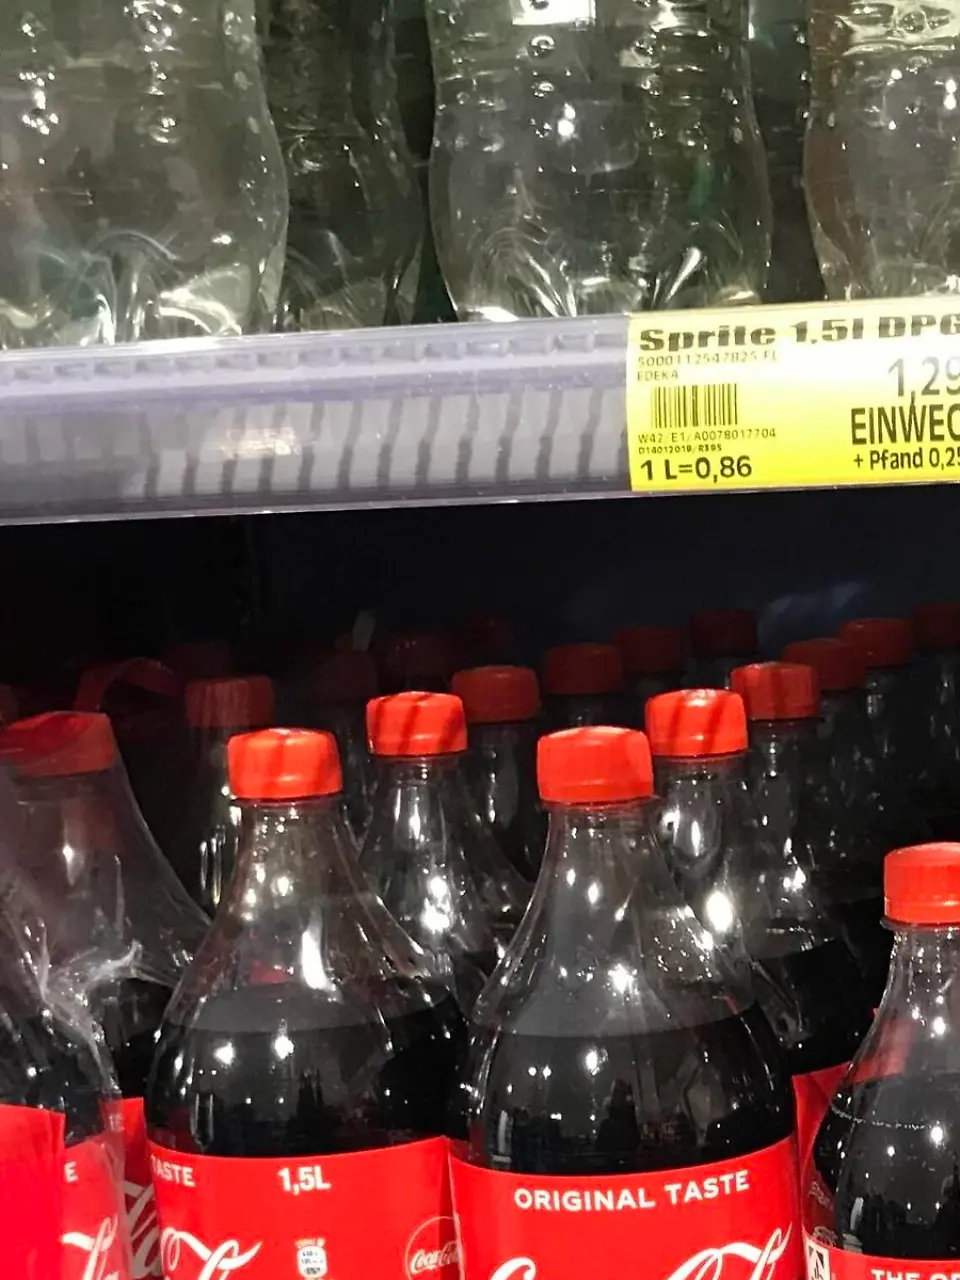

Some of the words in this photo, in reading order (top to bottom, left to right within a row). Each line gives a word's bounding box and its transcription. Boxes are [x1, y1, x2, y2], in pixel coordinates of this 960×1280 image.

[640, 325, 776, 352] Sprite
[640, 460, 653, 481] 1
[665, 455, 753, 483] L=0,86
[853, 455, 864, 467] +
[870, 448, 924, 471] Pfand
[278, 1165, 331, 1195] 1,5L
[514, 1187, 655, 1212] ORIGINAL
[664, 1169, 750, 1205] TASTE
